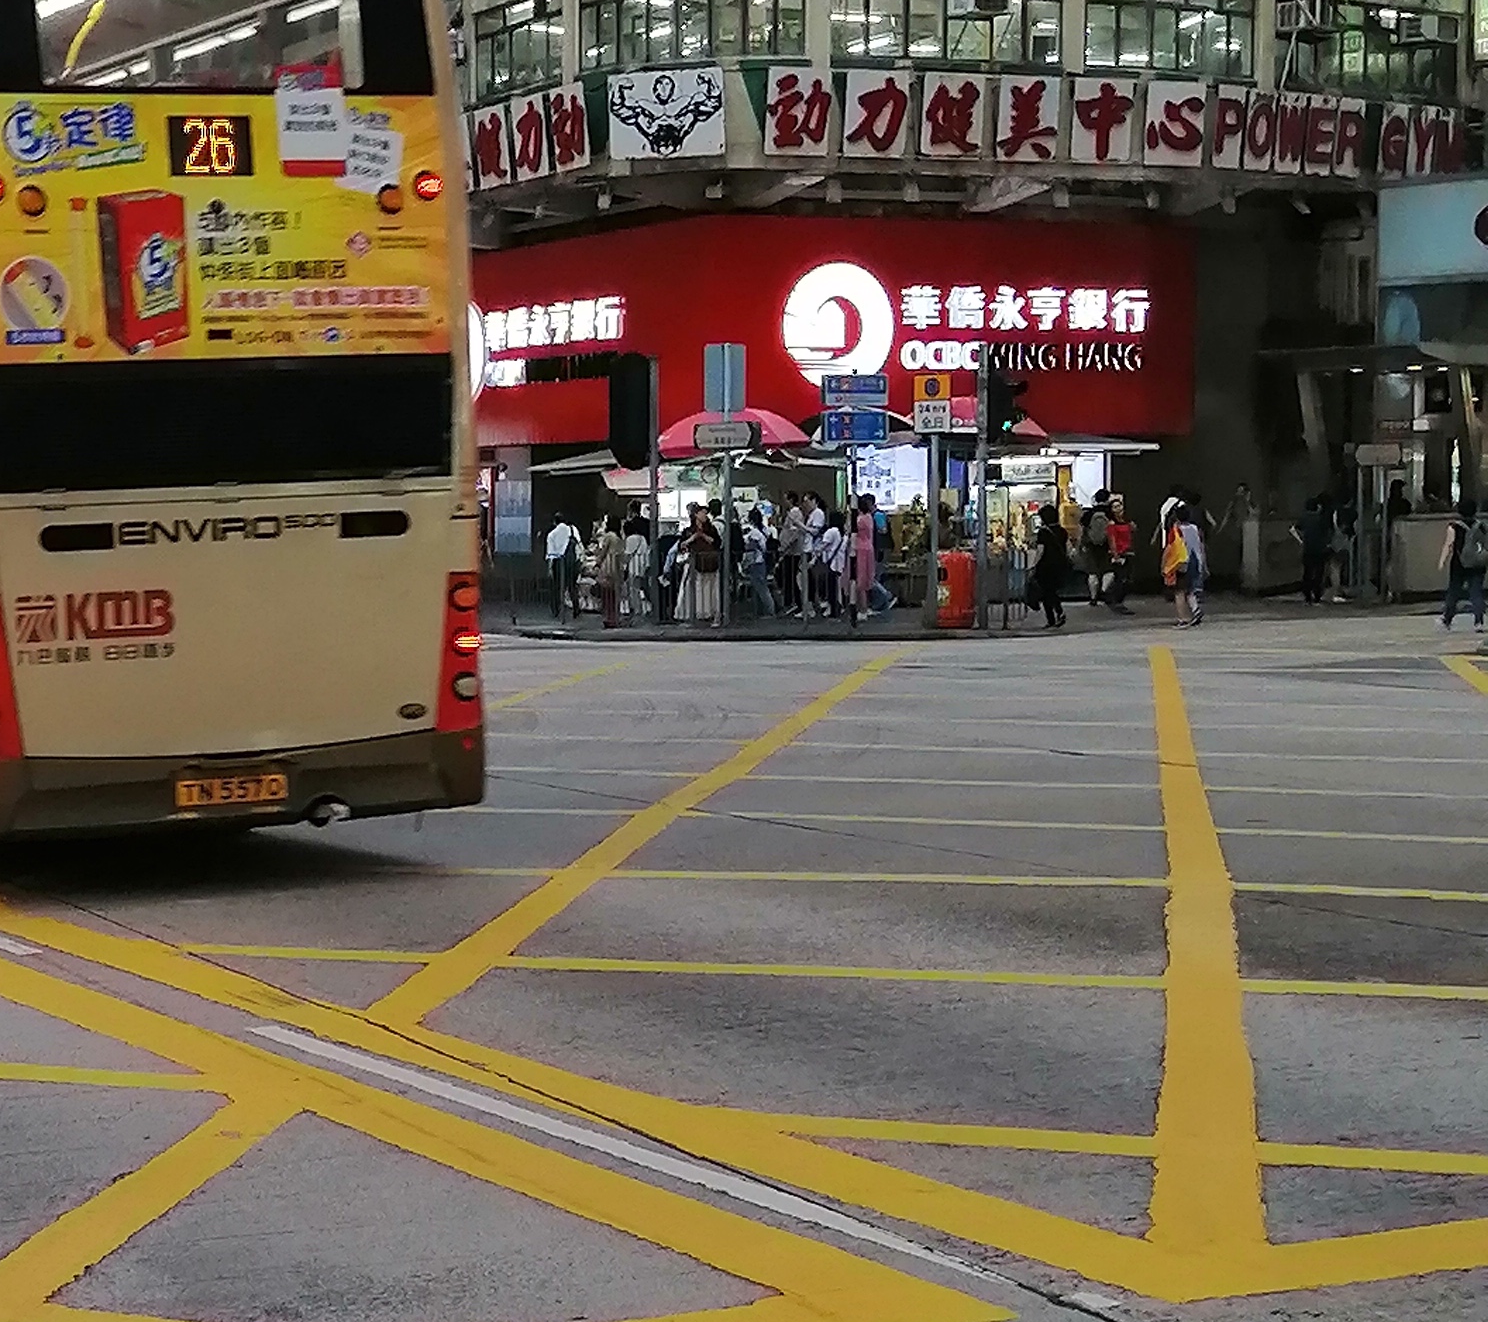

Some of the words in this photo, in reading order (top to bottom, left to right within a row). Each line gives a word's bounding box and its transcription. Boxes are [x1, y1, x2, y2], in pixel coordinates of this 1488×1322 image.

[767, 73, 1206, 161] 動力健美中心
[1213, 96, 1366, 169] POWER
[1380, 114, 1466, 175] GYM
[183, 117, 236, 174] 26
[900, 283, 1153, 333] 華僑永亨銀行
[900, 340, 981, 371] OCBC
[65, 588, 176, 641] KMB
[181, 782, 214, 804] TN
[220, 777, 282, 800] 5570
